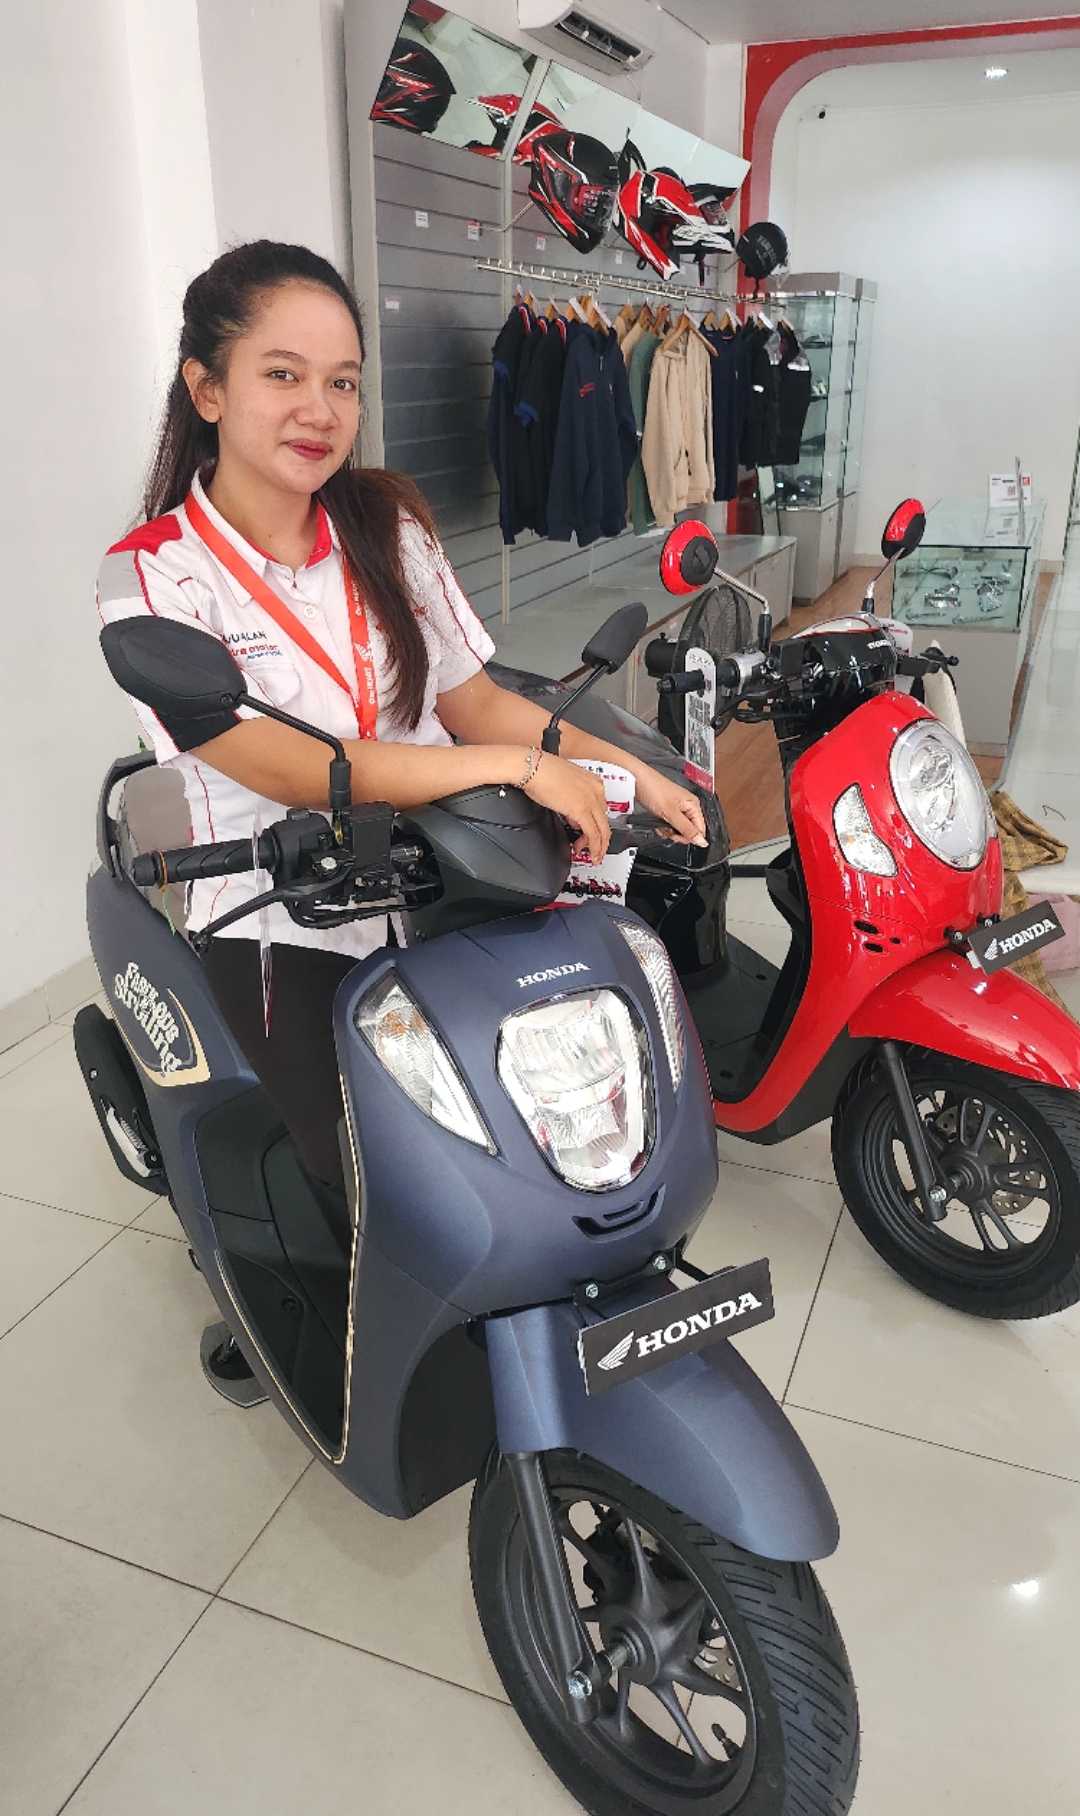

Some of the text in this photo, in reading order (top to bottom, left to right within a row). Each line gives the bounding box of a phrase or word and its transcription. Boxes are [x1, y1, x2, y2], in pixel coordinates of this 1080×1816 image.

[998, 918, 1057, 955] HONDA
[516, 961, 592, 988] HONDA
[636, 1291, 763, 1358] HONDA
